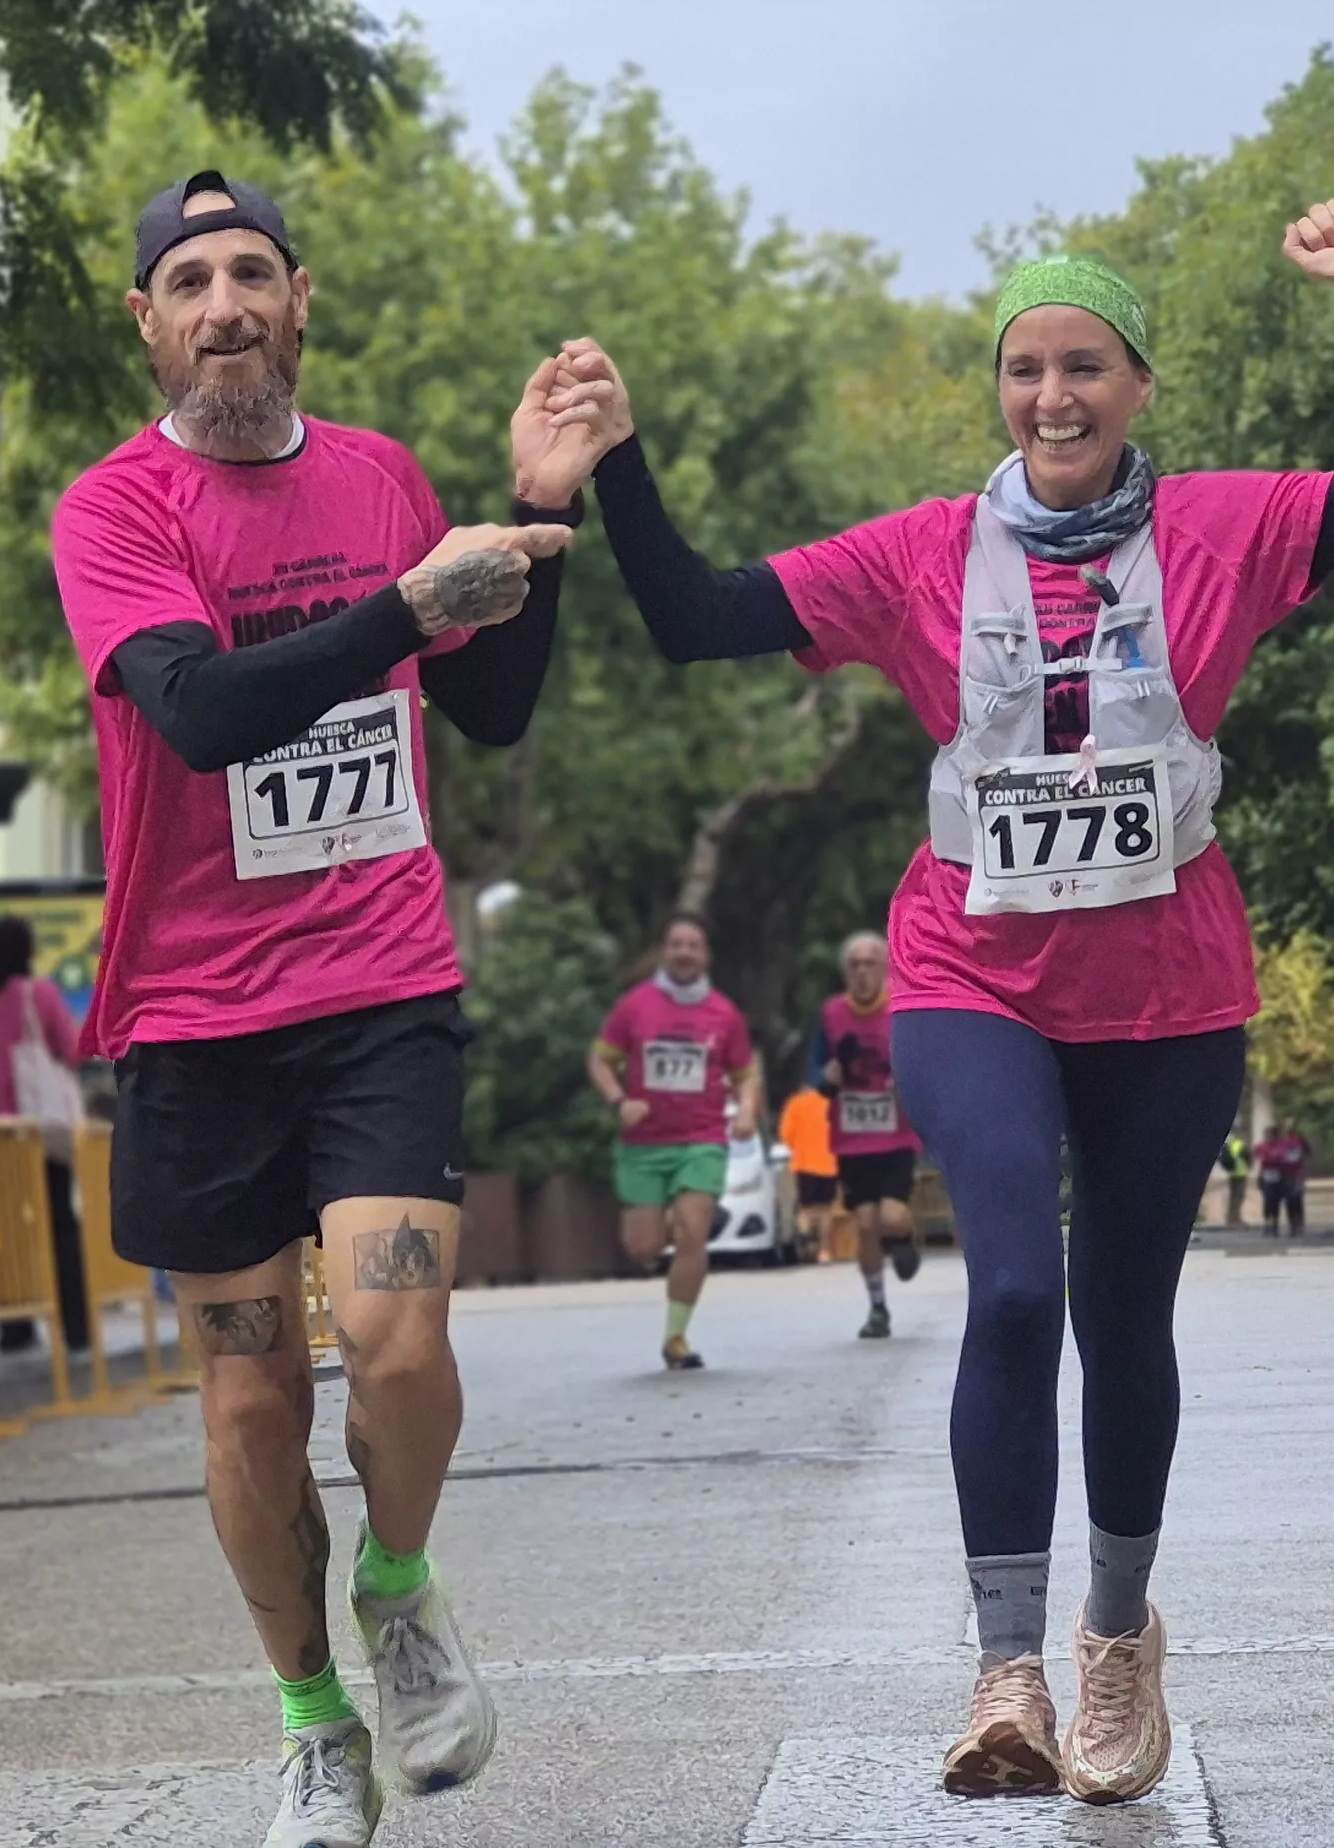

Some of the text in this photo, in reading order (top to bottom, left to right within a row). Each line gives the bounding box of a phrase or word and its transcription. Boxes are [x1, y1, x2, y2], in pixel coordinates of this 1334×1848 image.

[308, 721, 355, 740] HUESCA
[326, 736, 345, 753] EL
[254, 747, 397, 828] 1777
[1035, 773, 1089, 787] HUES
[985, 786, 1051, 806] CONTRA
[1054, 786, 1074, 801] EL
[989, 802, 1153, 870] 1778
